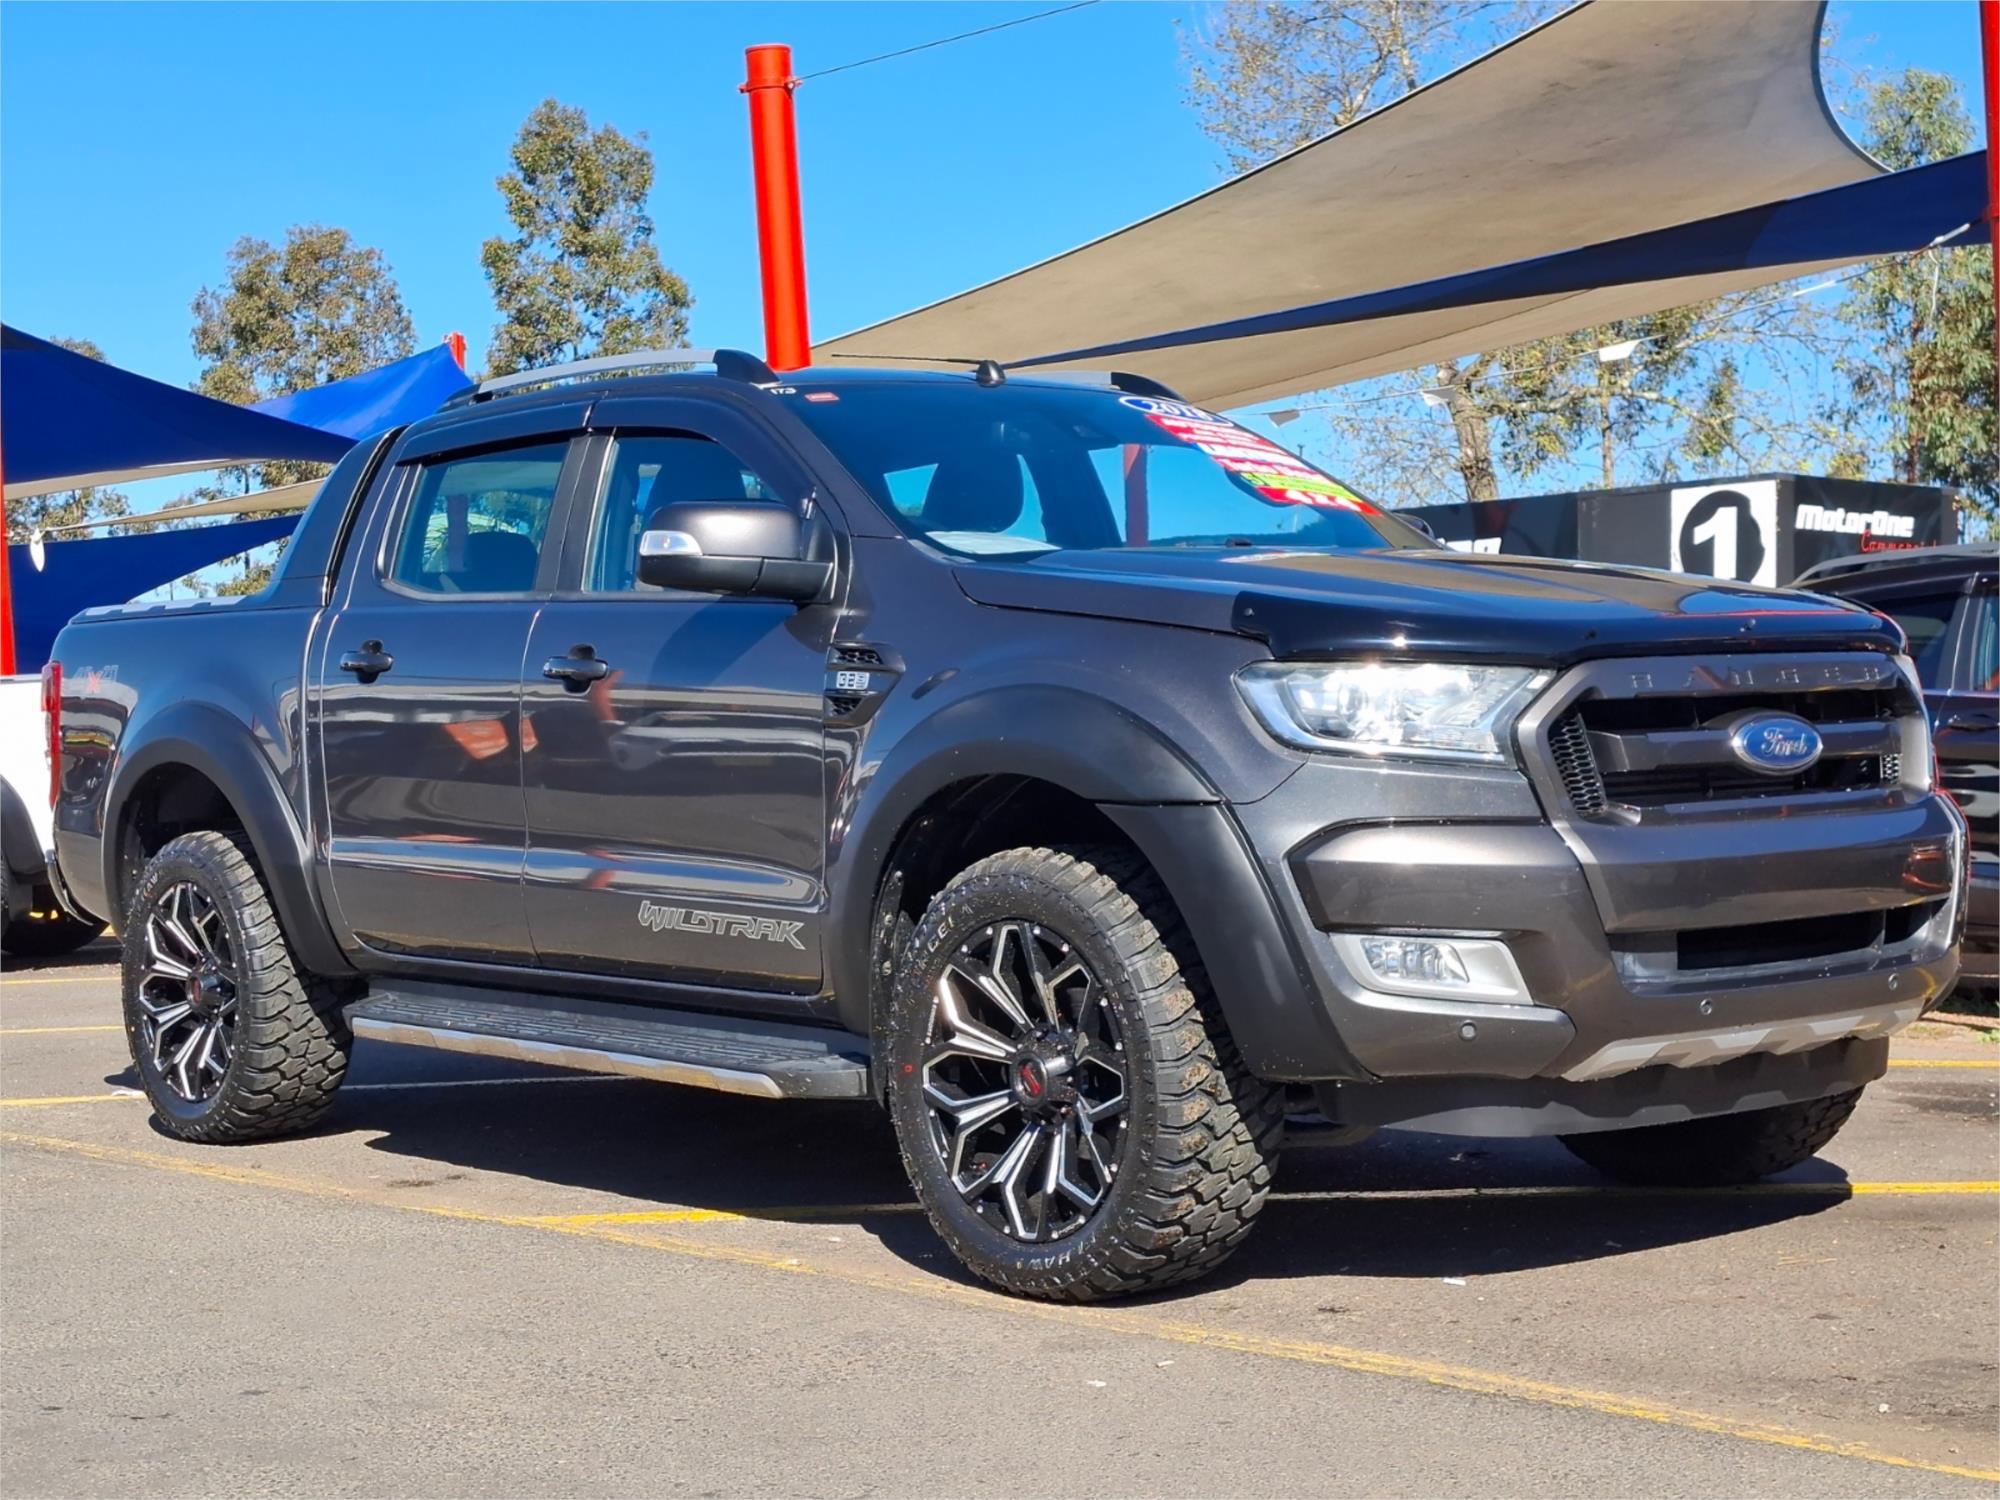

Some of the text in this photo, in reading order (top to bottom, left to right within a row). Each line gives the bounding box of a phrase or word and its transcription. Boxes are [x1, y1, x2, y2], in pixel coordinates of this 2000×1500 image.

[1795, 504, 1915, 537] MotorOne
[1693, 506, 1738, 580] 1
[1761, 727, 1808, 757] Ford
[638, 900, 806, 950] WILDTRAK
